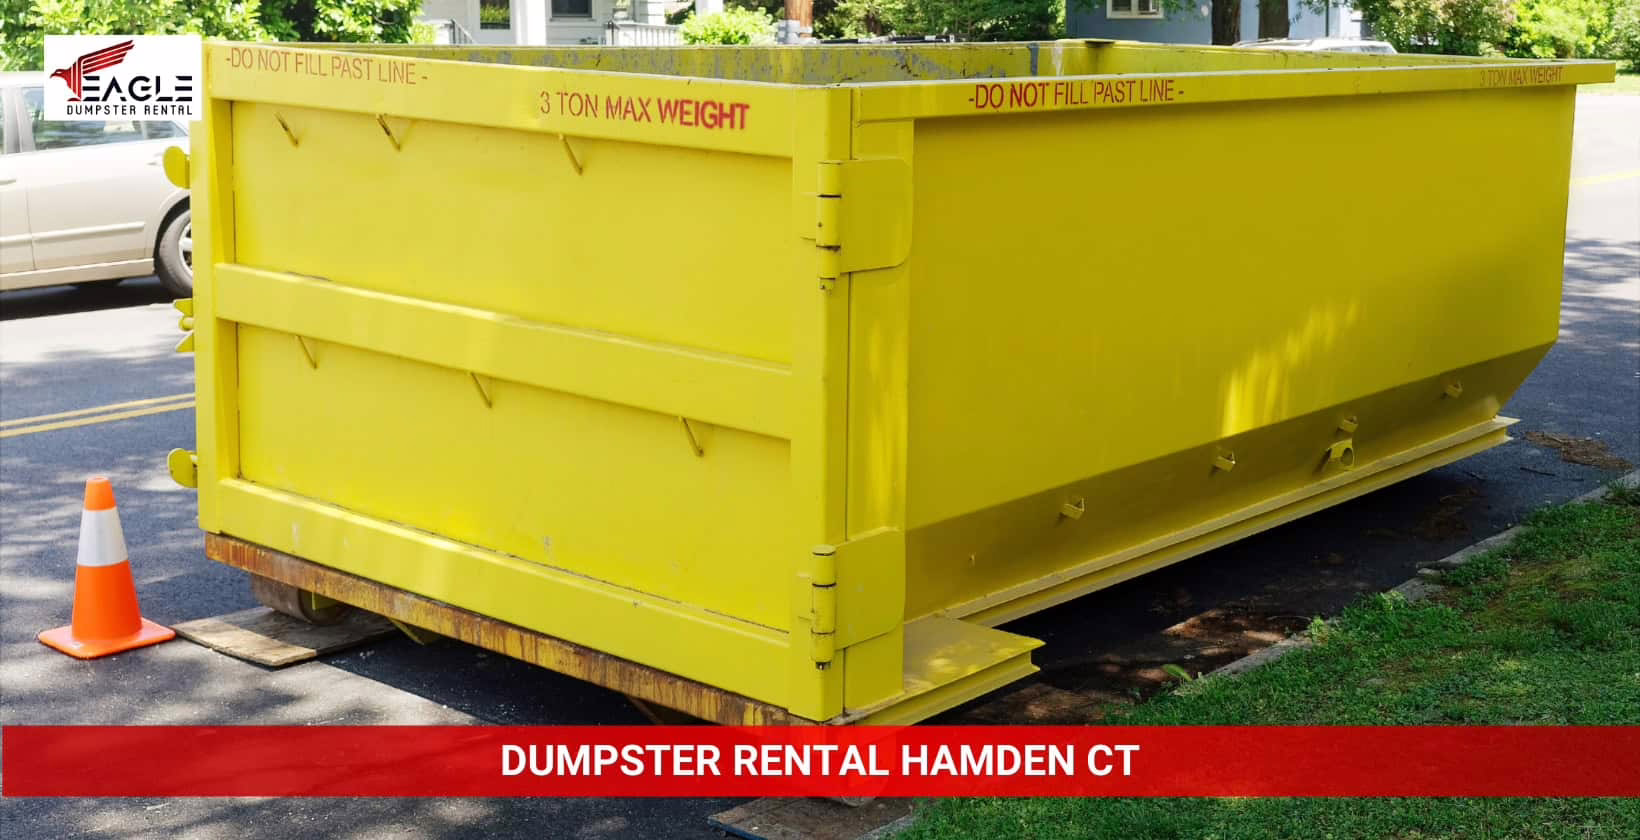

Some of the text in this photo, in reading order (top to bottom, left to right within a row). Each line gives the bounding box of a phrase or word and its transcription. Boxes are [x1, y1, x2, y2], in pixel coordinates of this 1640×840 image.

[257, 50, 290, 73] NOT
[294, 53, 328, 76] FILL
[331, 56, 373, 80] PAST
[377, 62, 416, 85] LINE
[1530, 65, 1563, 85] WEIGHT
[1009, 82, 1050, 108] NOT
[1054, 82, 1089, 105] FILL
[1092, 80, 1136, 104] PAST
[1140, 79, 1175, 102] LINE
[540, 91, 750, 130] 3 TON MAX WEIGHT
